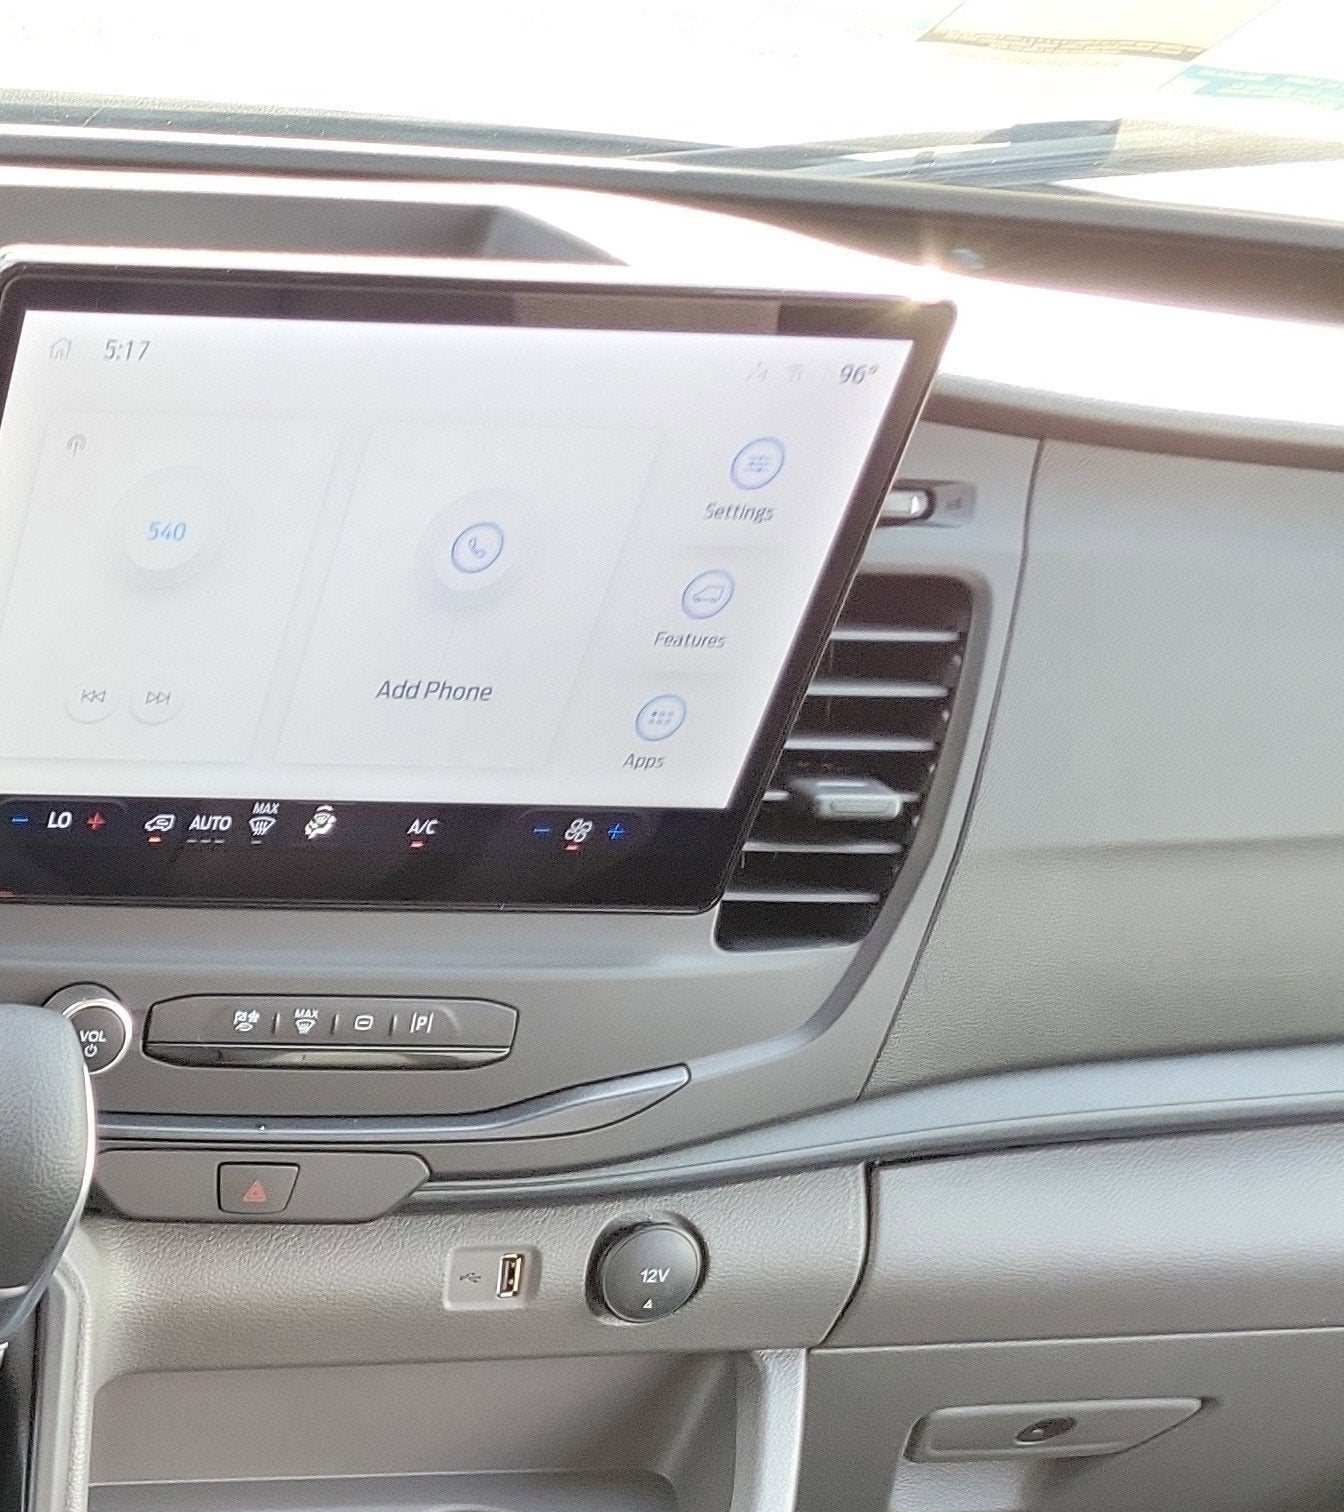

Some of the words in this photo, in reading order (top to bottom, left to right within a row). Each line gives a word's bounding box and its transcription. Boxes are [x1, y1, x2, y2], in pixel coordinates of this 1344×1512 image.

[103, 338, 151, 361] 5:17
[705, 501, 776, 524] Settings
[146, 520, 188, 542] 540
[653, 631, 726, 650] Features
[376, 679, 422, 701] Add
[424, 680, 494, 703] Phone
[622, 752, 665, 770] Apps
[252, 802, 279, 815] MAX
[47, 811, 73, 829] LO
[188, 814, 232, 831] AUTO
[406, 818, 439, 835] A/C
[294, 1008, 319, 1019] MAX
[79, 1030, 107, 1044] VOL
[640, 1268, 670, 1284] 12V
